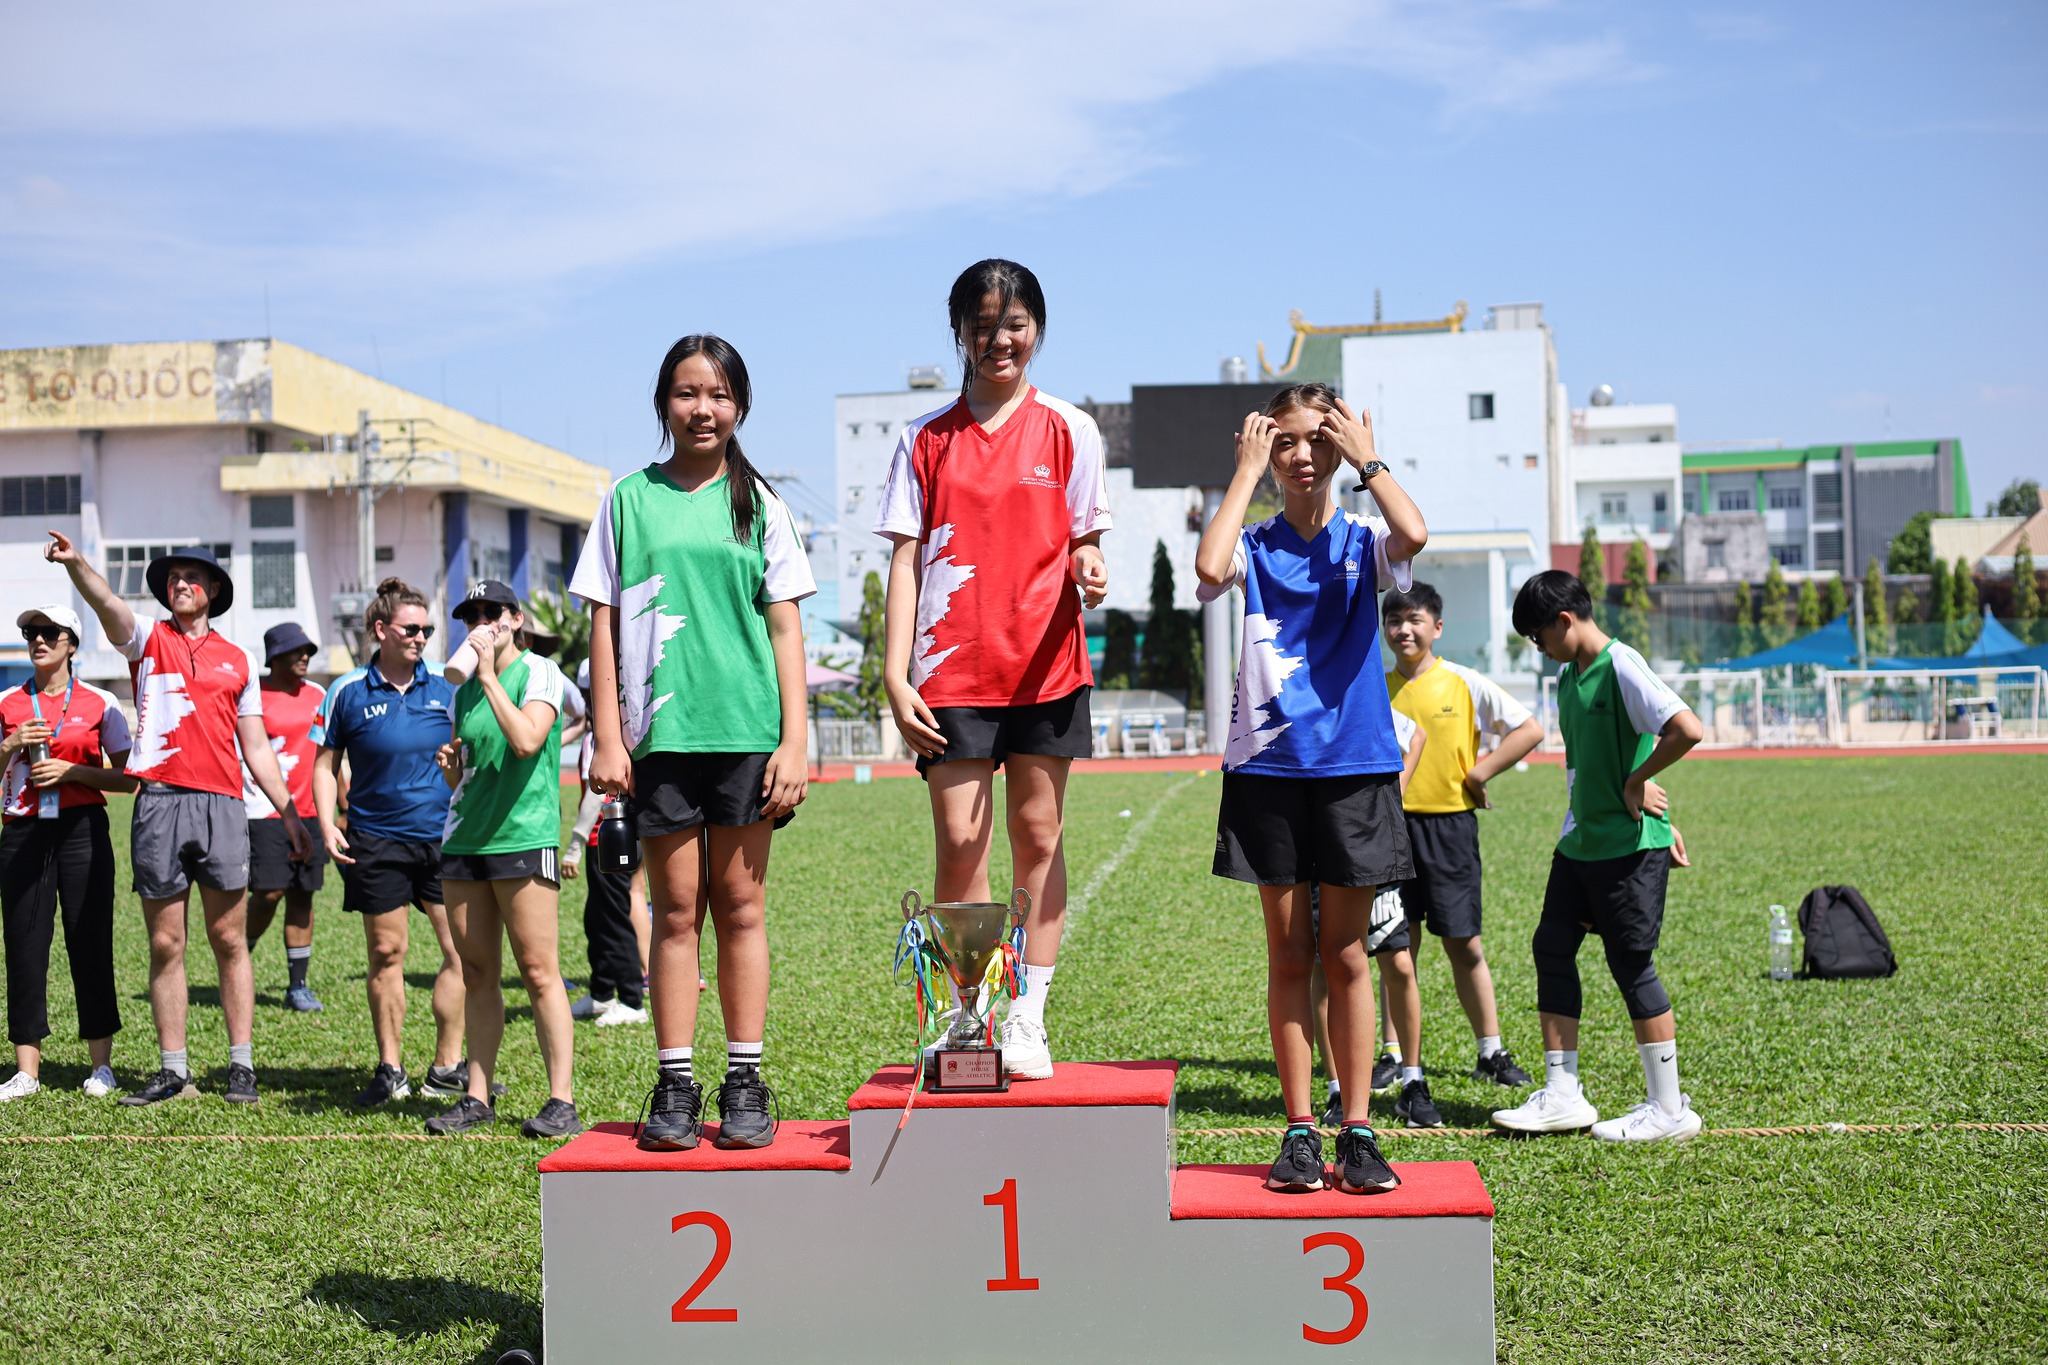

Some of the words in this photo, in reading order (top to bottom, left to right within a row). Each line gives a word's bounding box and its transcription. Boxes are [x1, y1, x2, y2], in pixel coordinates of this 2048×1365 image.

[91, 350, 212, 403] QUỐC
[363, 703, 388, 720] LW
[672, 1211, 738, 1322] 2
[983, 1178, 1040, 1292] 1
[1303, 1232, 1368, 1344] 3
